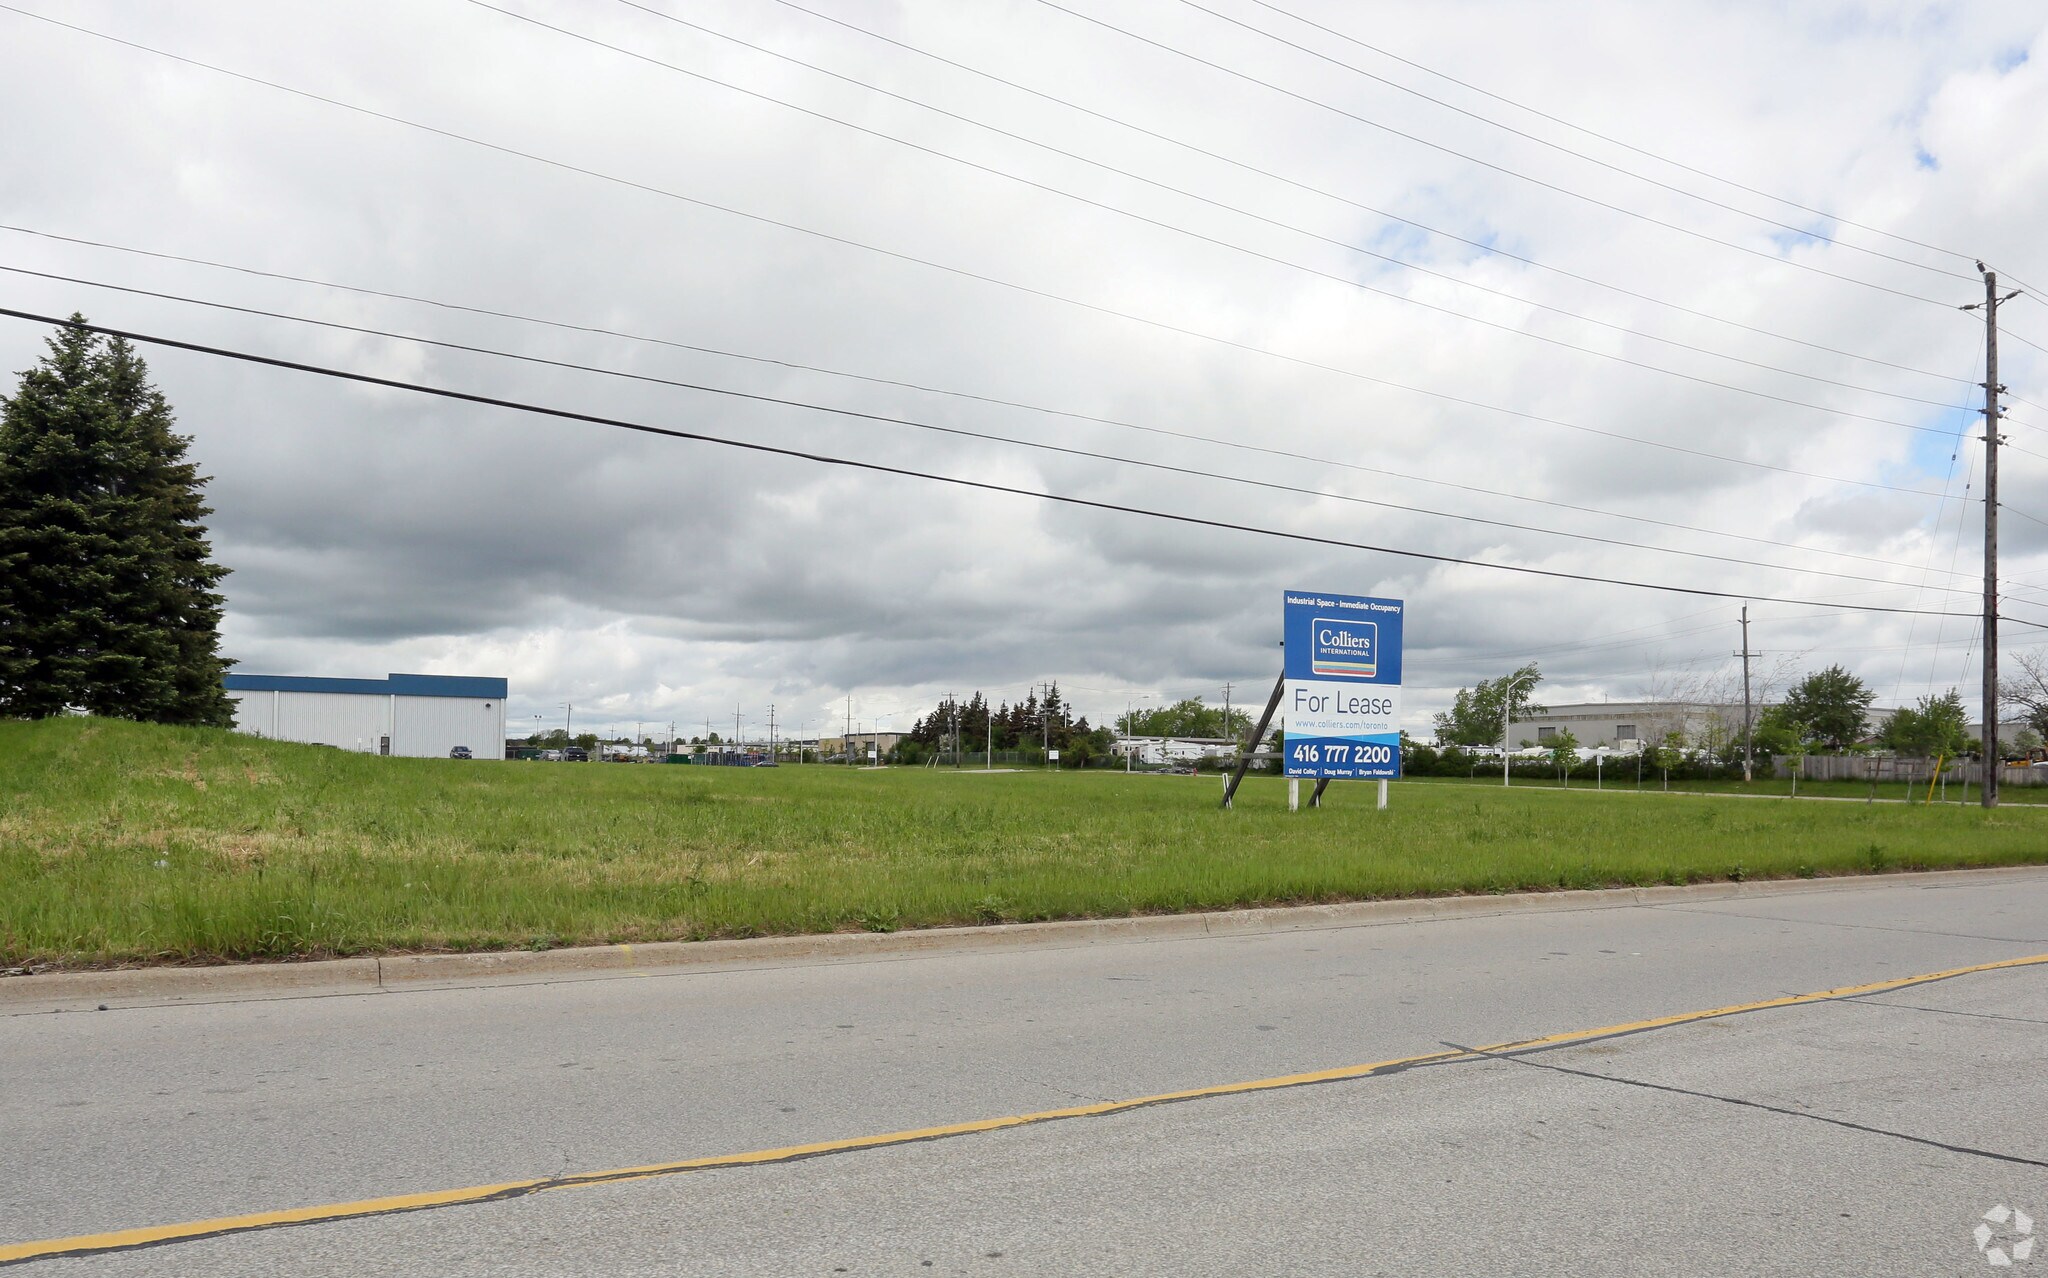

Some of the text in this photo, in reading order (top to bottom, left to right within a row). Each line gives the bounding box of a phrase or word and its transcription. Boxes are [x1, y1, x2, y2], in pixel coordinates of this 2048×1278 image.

[1287, 596, 1315, 606] Industrial
[1316, 599, 1335, 608] Space
[1339, 600, 1369, 610] Immediate
[1370, 603, 1401, 614] Occupancy
[1320, 629, 1370, 648] Colliers
[1320, 647, 1370, 656] INTERNATIONAL
[1295, 688, 1392, 715] For Lease
[1295, 720, 1388, 730] www.colliers.com/toronto
[1293, 744, 1391, 763] 416 777 2200
